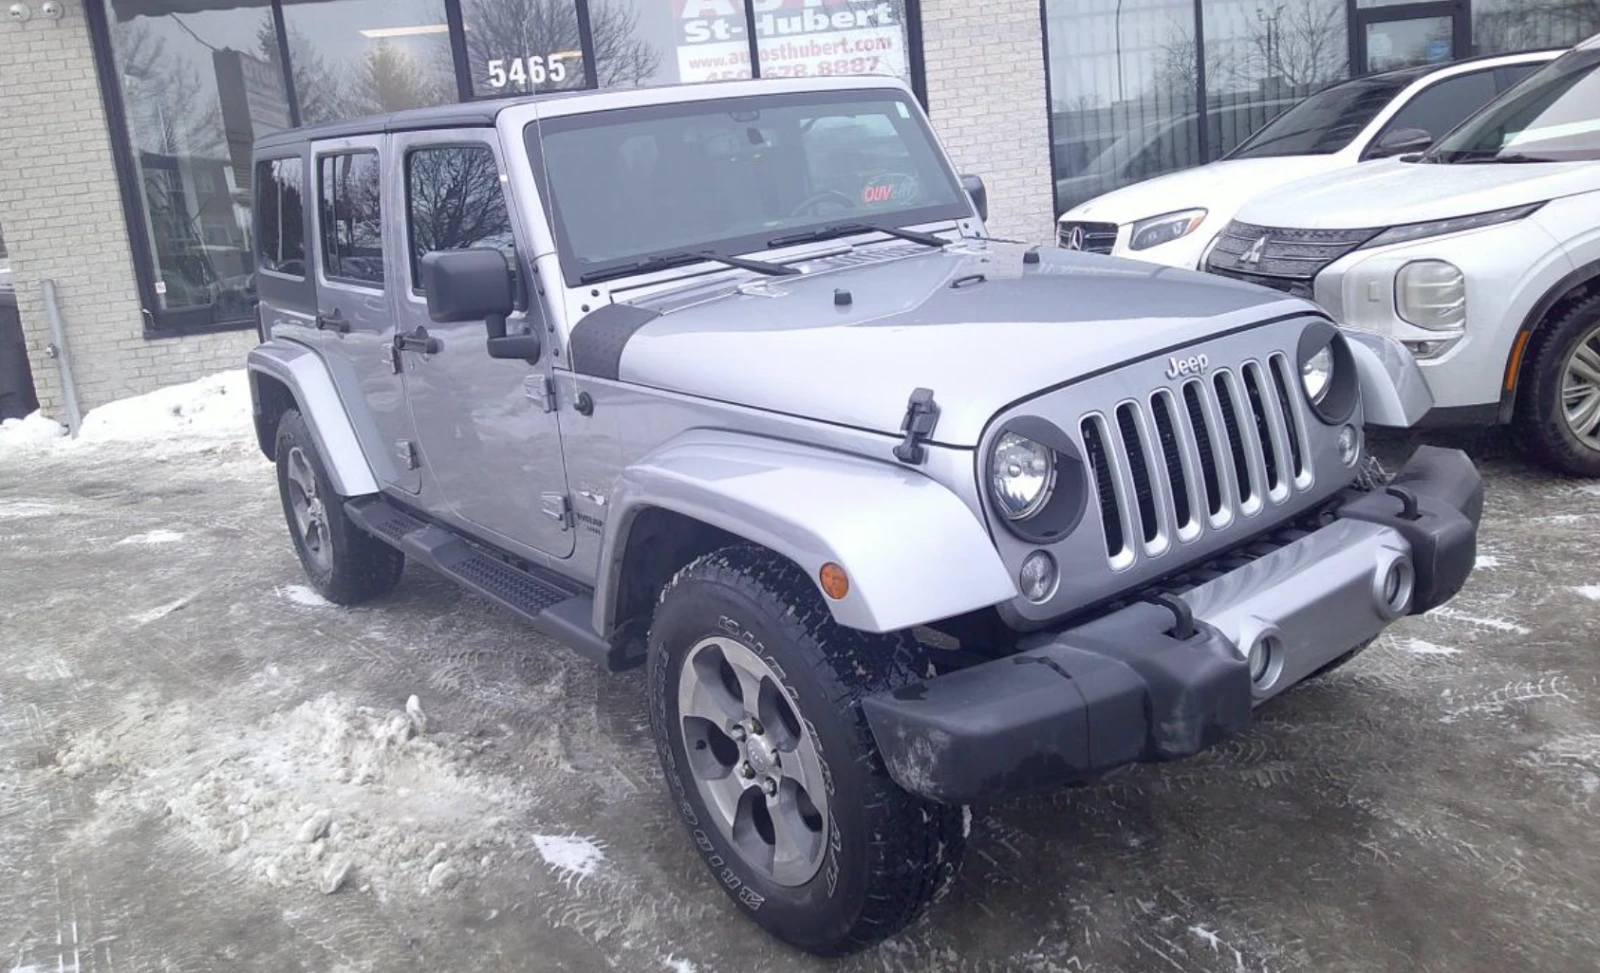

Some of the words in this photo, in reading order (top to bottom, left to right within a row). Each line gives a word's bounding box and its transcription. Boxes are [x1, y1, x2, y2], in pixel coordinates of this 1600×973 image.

[689, 37, 892, 69] www.auosthubert.com
[488, 53, 566, 88] 5465
[1165, 354, 1208, 379] Jeep
